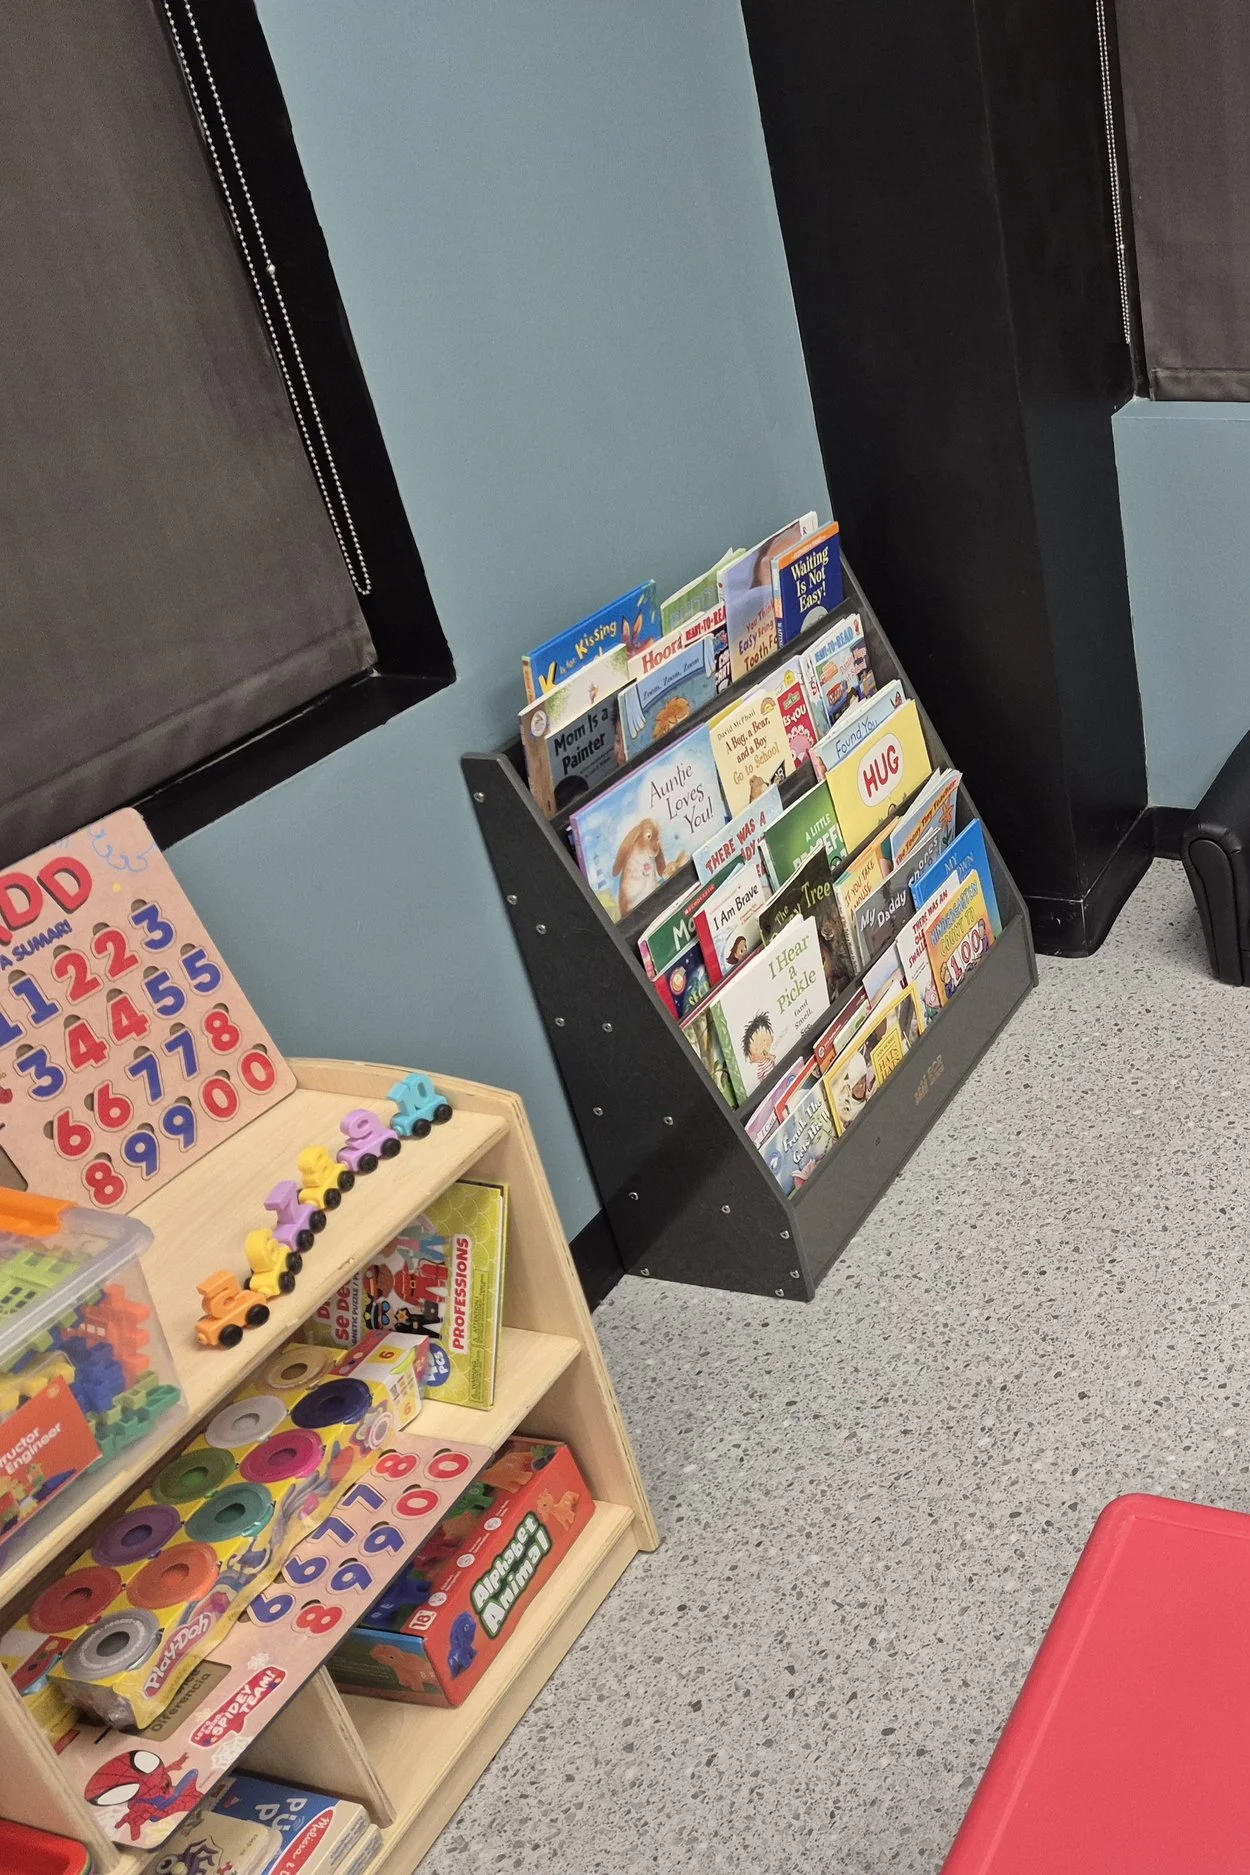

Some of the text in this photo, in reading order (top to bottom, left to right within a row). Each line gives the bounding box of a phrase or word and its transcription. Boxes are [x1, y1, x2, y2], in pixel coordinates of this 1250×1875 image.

[791, 546, 829, 581] Waiting
[796, 566, 826, 597] Is Not
[800, 581, 826, 614] Easy!
[685, 605, 726, 643] READY-TO-REA
[739, 633, 757, 655] Easy
[642, 636, 682, 674] Hoora
[744, 646, 769, 671] Tooth
[554, 707, 609, 756] Mom Is a
[717, 710, 756, 741] David McPhail
[726, 717, 770, 755] A Bag, a Bear,
[835, 725, 861, 759] Found
[562, 732, 606, 776] Painter
[733, 742, 780, 785] Go to School
[737, 736, 768, 764] and a Boy
[863, 745, 899, 798] HUG
[650, 763, 693, 808] Auntie
[666, 784, 704, 821] Loves
[684, 796, 713, 833] You!
[805, 813, 832, 842] A LITTLE
[705, 838, 736, 875] THERE
[736, 818, 756, 845] WAS
[760, 811, 767, 826] A
[944, 852, 959, 875] MY
[0, 857, 93, 947] DD
[713, 917, 719, 930] I
[721, 905, 736, 926] Am
[735, 884, 759, 911] Brave
[802, 881, 831, 904] Tree
[851, 878, 862, 898] YOU
[775, 905, 789, 926] The
[860, 907, 875, 932] My
[877, 890, 906, 927] Daddy
[912, 889, 948, 934] THERE WAS AN
[12, 919, 73, 962] SUMAR!
[768, 937, 810, 981] I Hear
[908, 942, 927, 968] SWALL
[950, 929, 981, 981] 100
[12, 977, 59, 1025] 1
[54, 952, 101, 1001] 2
[94, 930, 139, 978] 2
[131, 904, 174, 950] 3
[788, 966, 797, 981] a
[776, 968, 817, 1015] Pickle
[793, 1000, 809, 1018] (and
[17, 949, 222, 1098] 3 4 4 5 5
[57, 1010, 240, 1156] 6 6 7 7 8
[85, 1051, 277, 1205] 8 9 9 0 0
[352, 1285, 360, 1316] PUZZLE
[452, 1237, 470, 1350] PROFESSIONS
[434, 1350, 448, 1374] PCS
[5, 1422, 62, 1476] Engineer
[250, 1453, 418, 1623] 6 6 7 7 8
[296, 1452, 471, 1634] 8 9 9 0 0
[471, 1514, 539, 1608] Alphabet
[481, 1530, 550, 1635] Animal
[145, 1613, 212, 1690] Play-Doh
[151, 1672, 211, 1732] Diferencia
[212, 1684, 252, 1735] SPIDEY
[239, 1670, 277, 1714] TEAM!
[292, 1816, 330, 1859] Melissa
